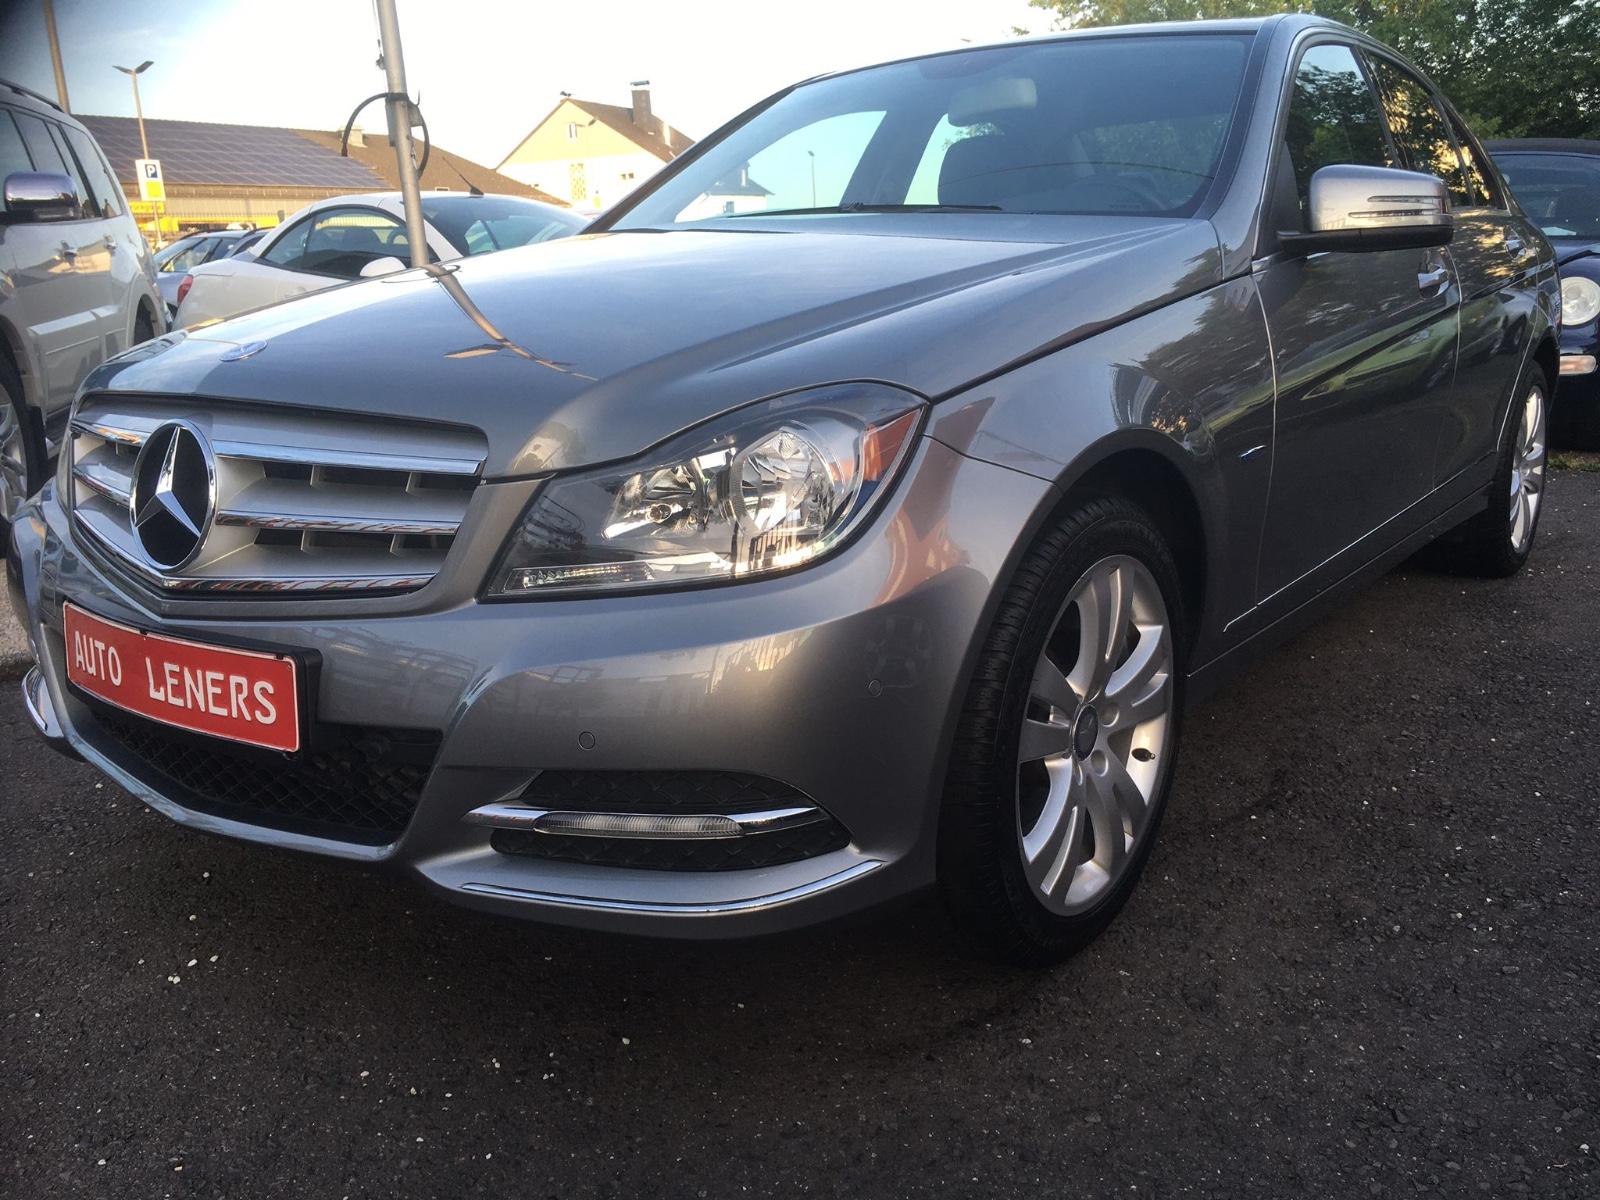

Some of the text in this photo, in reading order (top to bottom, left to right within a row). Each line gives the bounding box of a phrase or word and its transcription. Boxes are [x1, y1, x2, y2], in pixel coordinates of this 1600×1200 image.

[146, 165, 156, 178] P
[74, 630, 277, 725] AUTO LENERS
